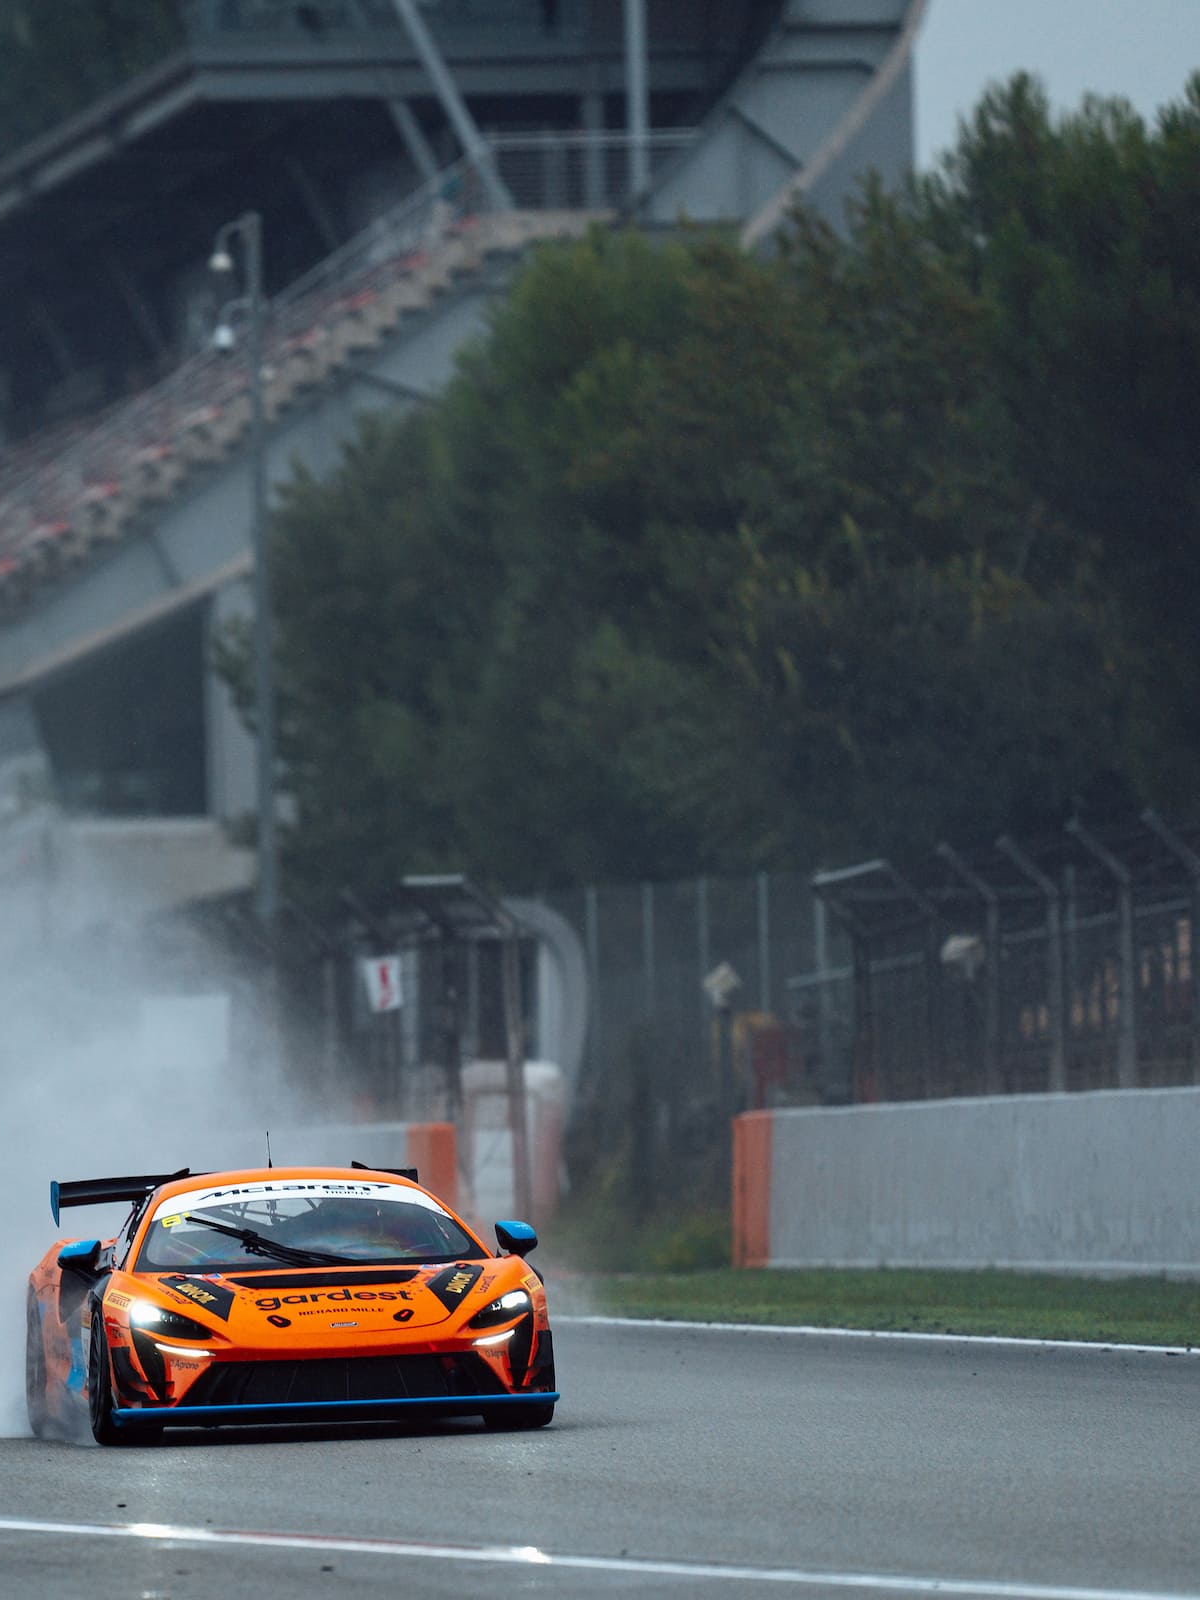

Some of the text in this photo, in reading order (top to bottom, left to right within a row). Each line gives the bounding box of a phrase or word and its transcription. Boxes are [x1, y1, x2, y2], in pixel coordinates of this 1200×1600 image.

[198, 1183, 388, 1201] McLaren
[108, 1292, 130, 1309] PIRELLI
[255, 1288, 414, 1311] gardest
[298, 1308, 349, 1317] RICHARD
